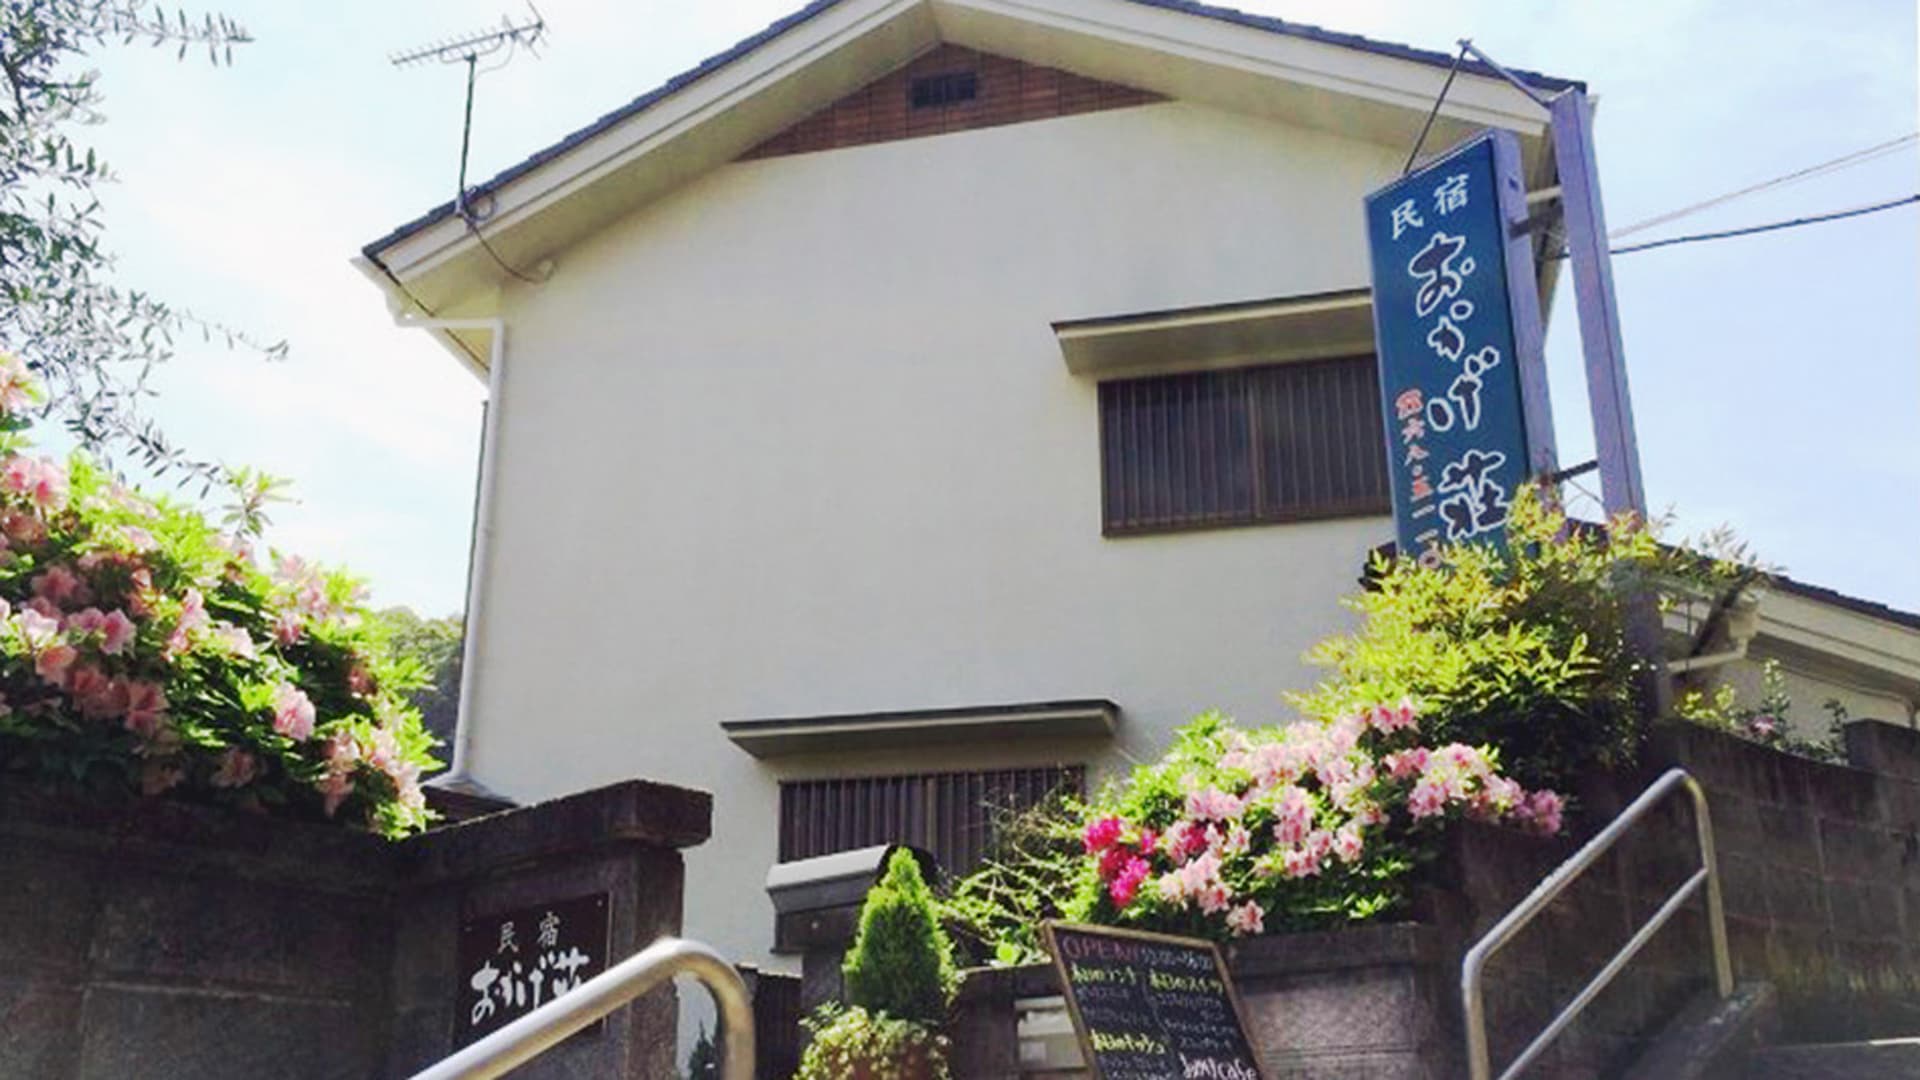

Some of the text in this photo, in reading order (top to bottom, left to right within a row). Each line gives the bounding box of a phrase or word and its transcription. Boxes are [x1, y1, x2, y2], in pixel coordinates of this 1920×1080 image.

[1392, 173, 1469, 240] 民宿
[1408, 231, 1508, 541] おかげ荘
[497, 911, 561, 954] 民宿
